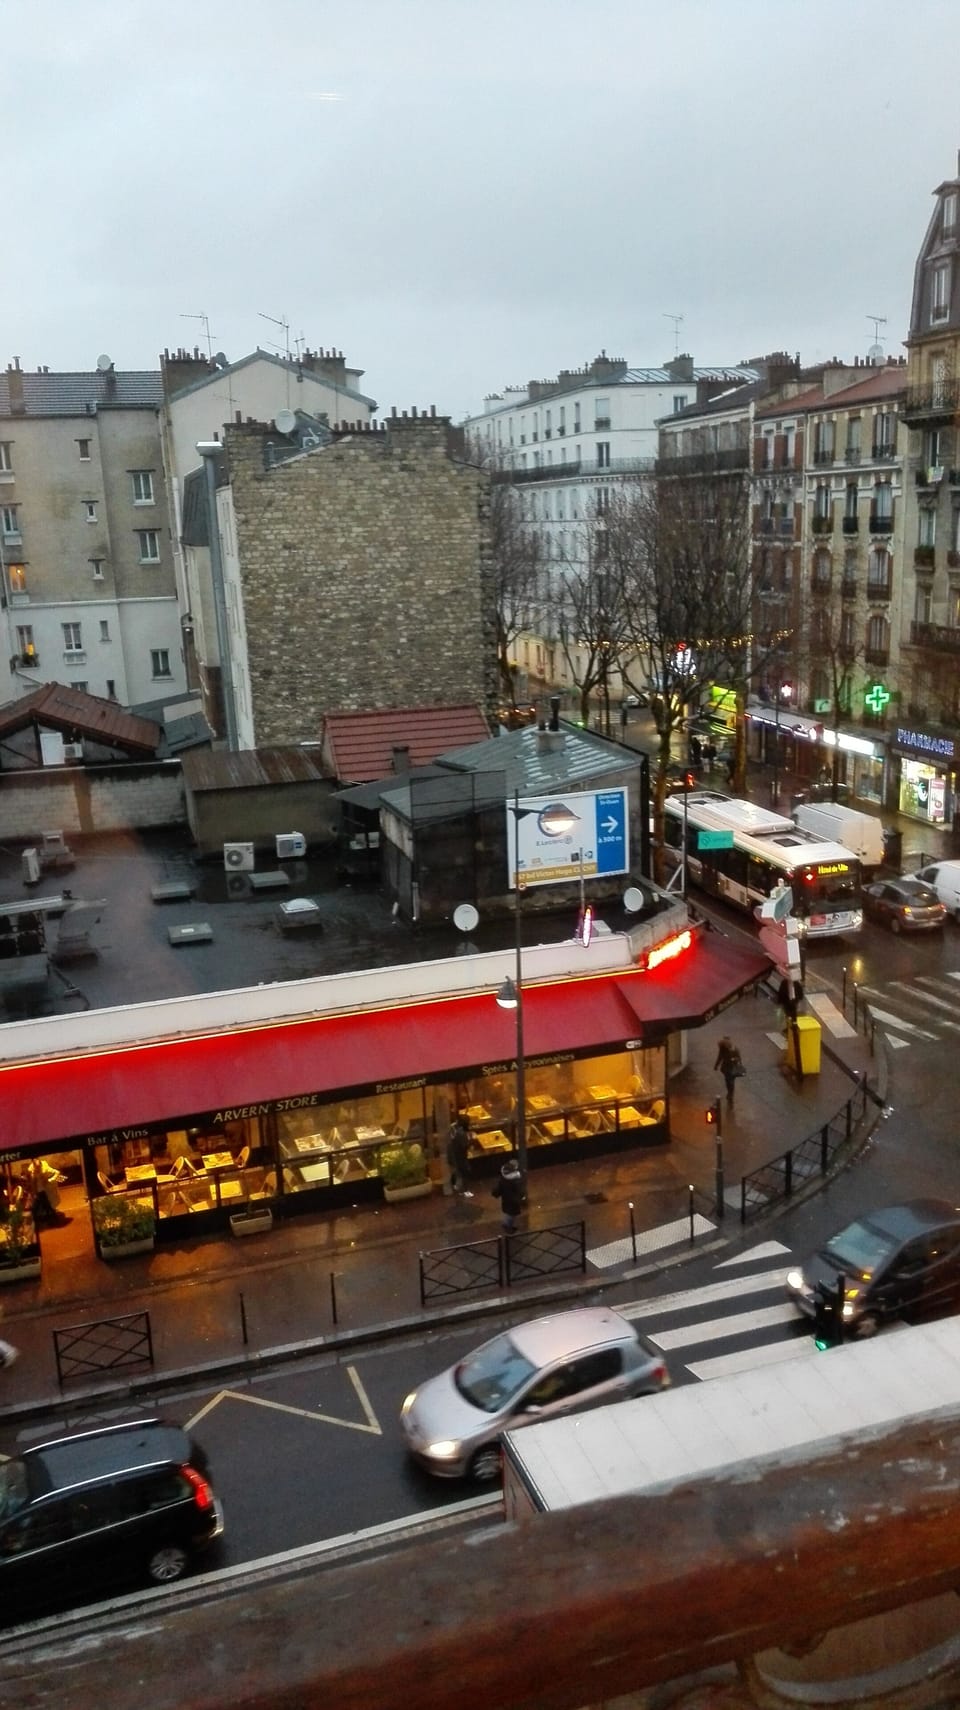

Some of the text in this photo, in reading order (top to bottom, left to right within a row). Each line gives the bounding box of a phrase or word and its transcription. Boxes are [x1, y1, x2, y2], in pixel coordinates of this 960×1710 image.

[897, 728, 955, 756] PHARMACIE
[376, 1078, 427, 1094] Restaurant
[275, 1095, 318, 1112] STORE
[87, 1136, 107, 1146] Bar
[122, 1128, 149, 1140] Vins
